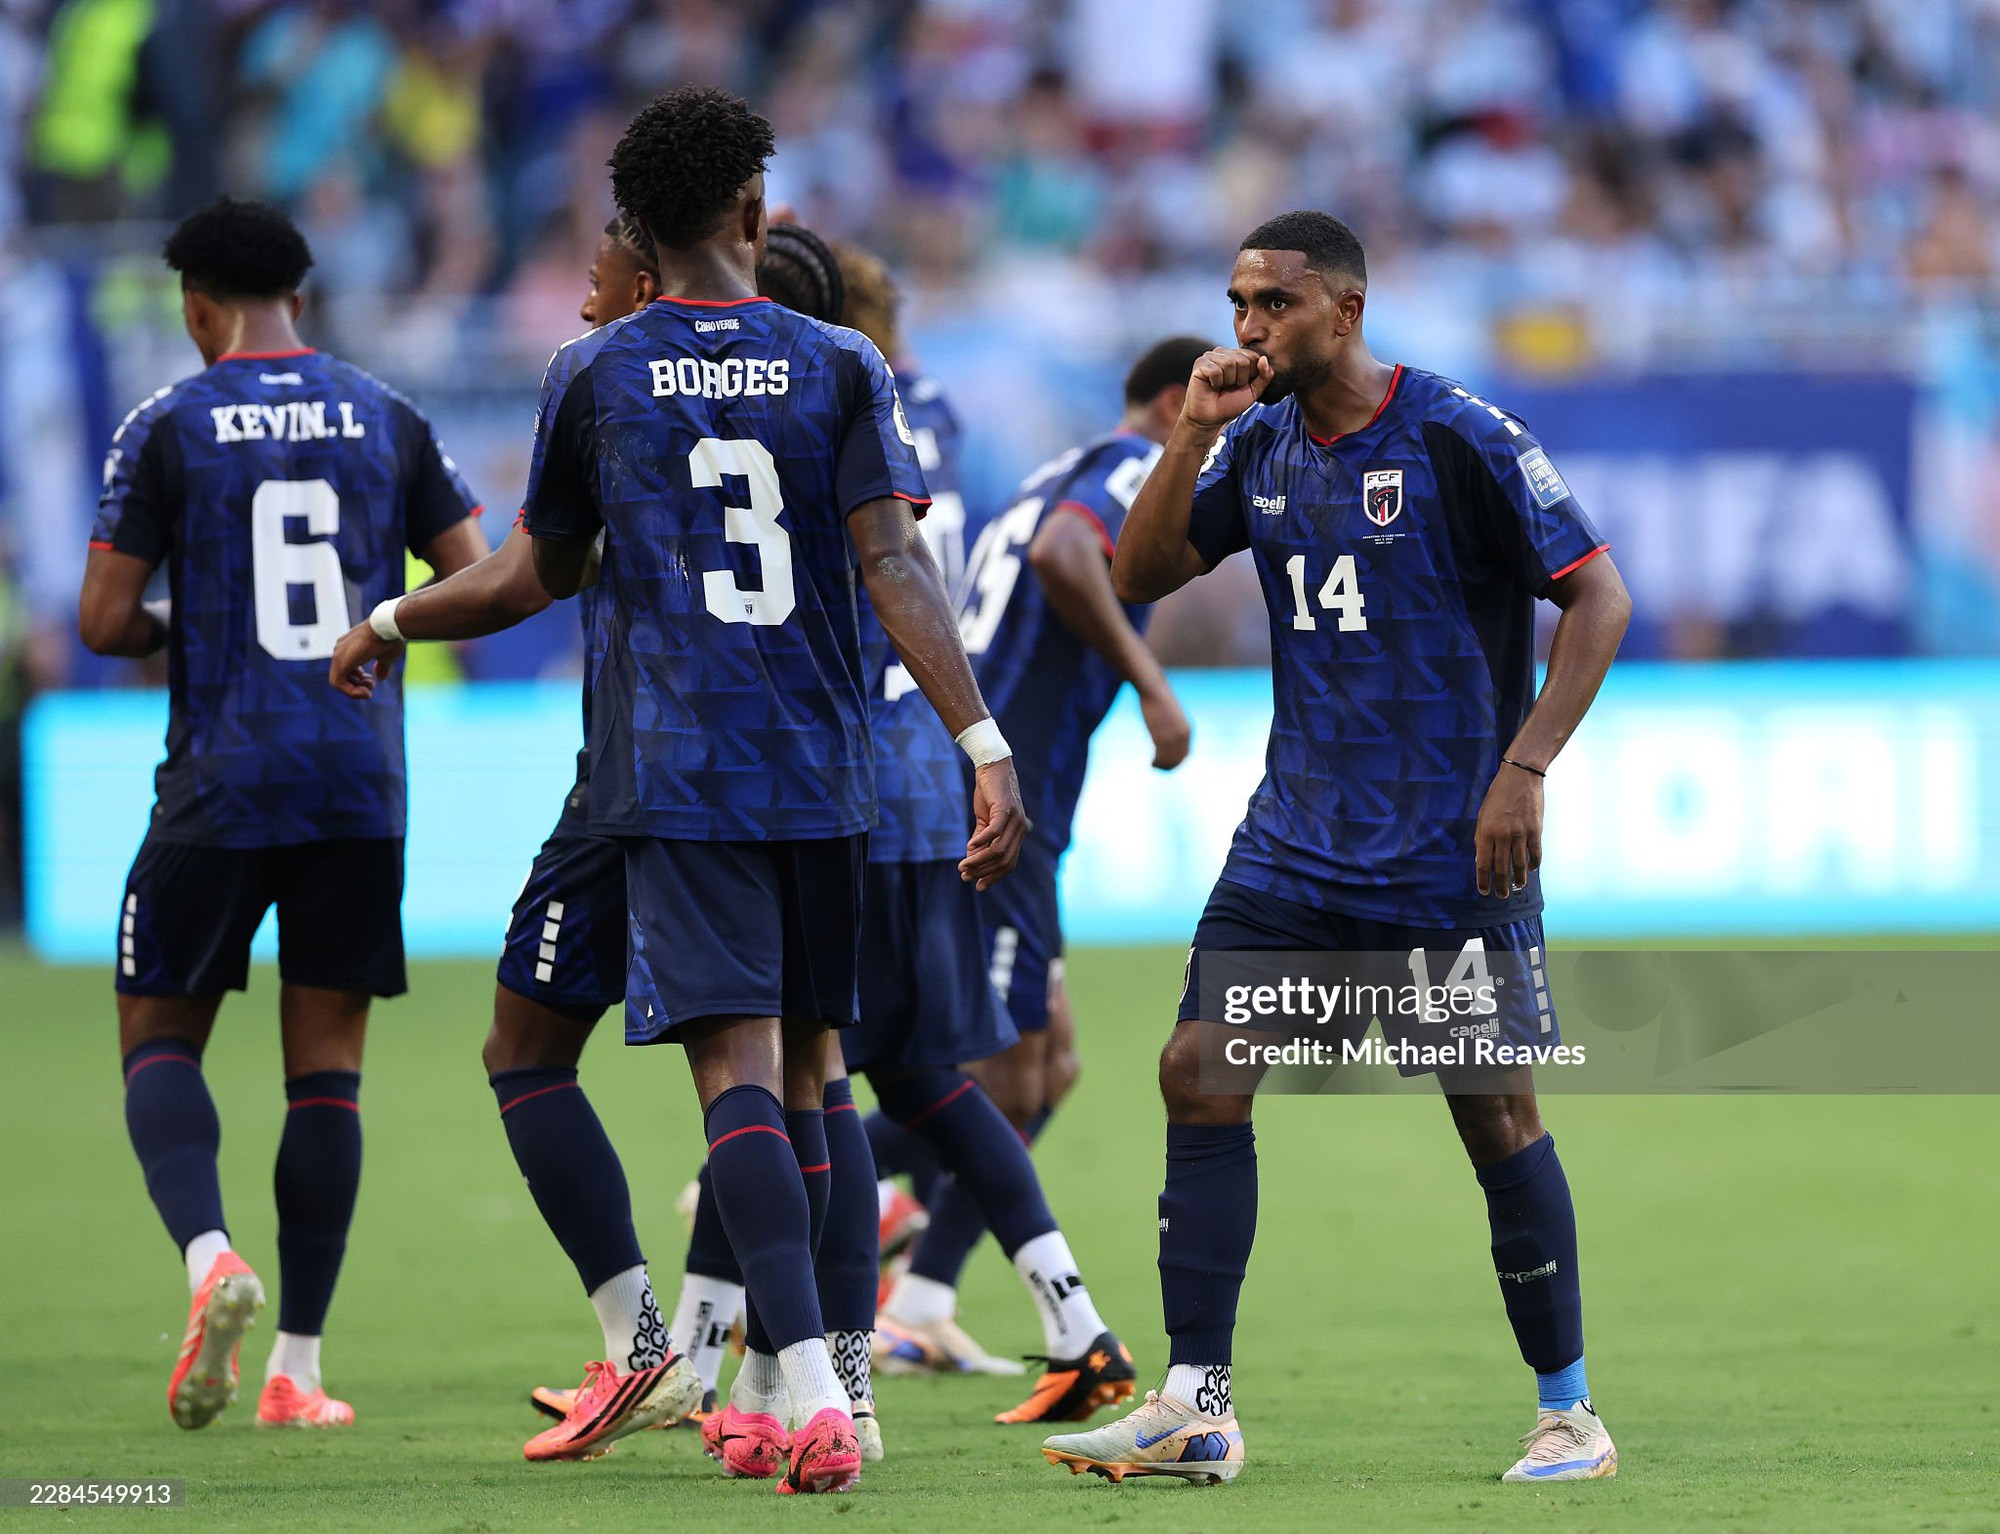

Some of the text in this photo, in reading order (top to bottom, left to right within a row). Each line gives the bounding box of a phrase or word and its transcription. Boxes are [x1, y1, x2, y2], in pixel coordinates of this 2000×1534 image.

[715, 318, 740, 331] VERDE
[648, 357, 790, 400] BORGES
[1367, 473, 1400, 484] FCF
[688, 438, 796, 626] 3
[252, 479, 351, 661] 6
[1286, 554, 1368, 632] 14
[1407, 936, 1498, 1024] 14
[1449, 1018, 1500, 1040] capelli
